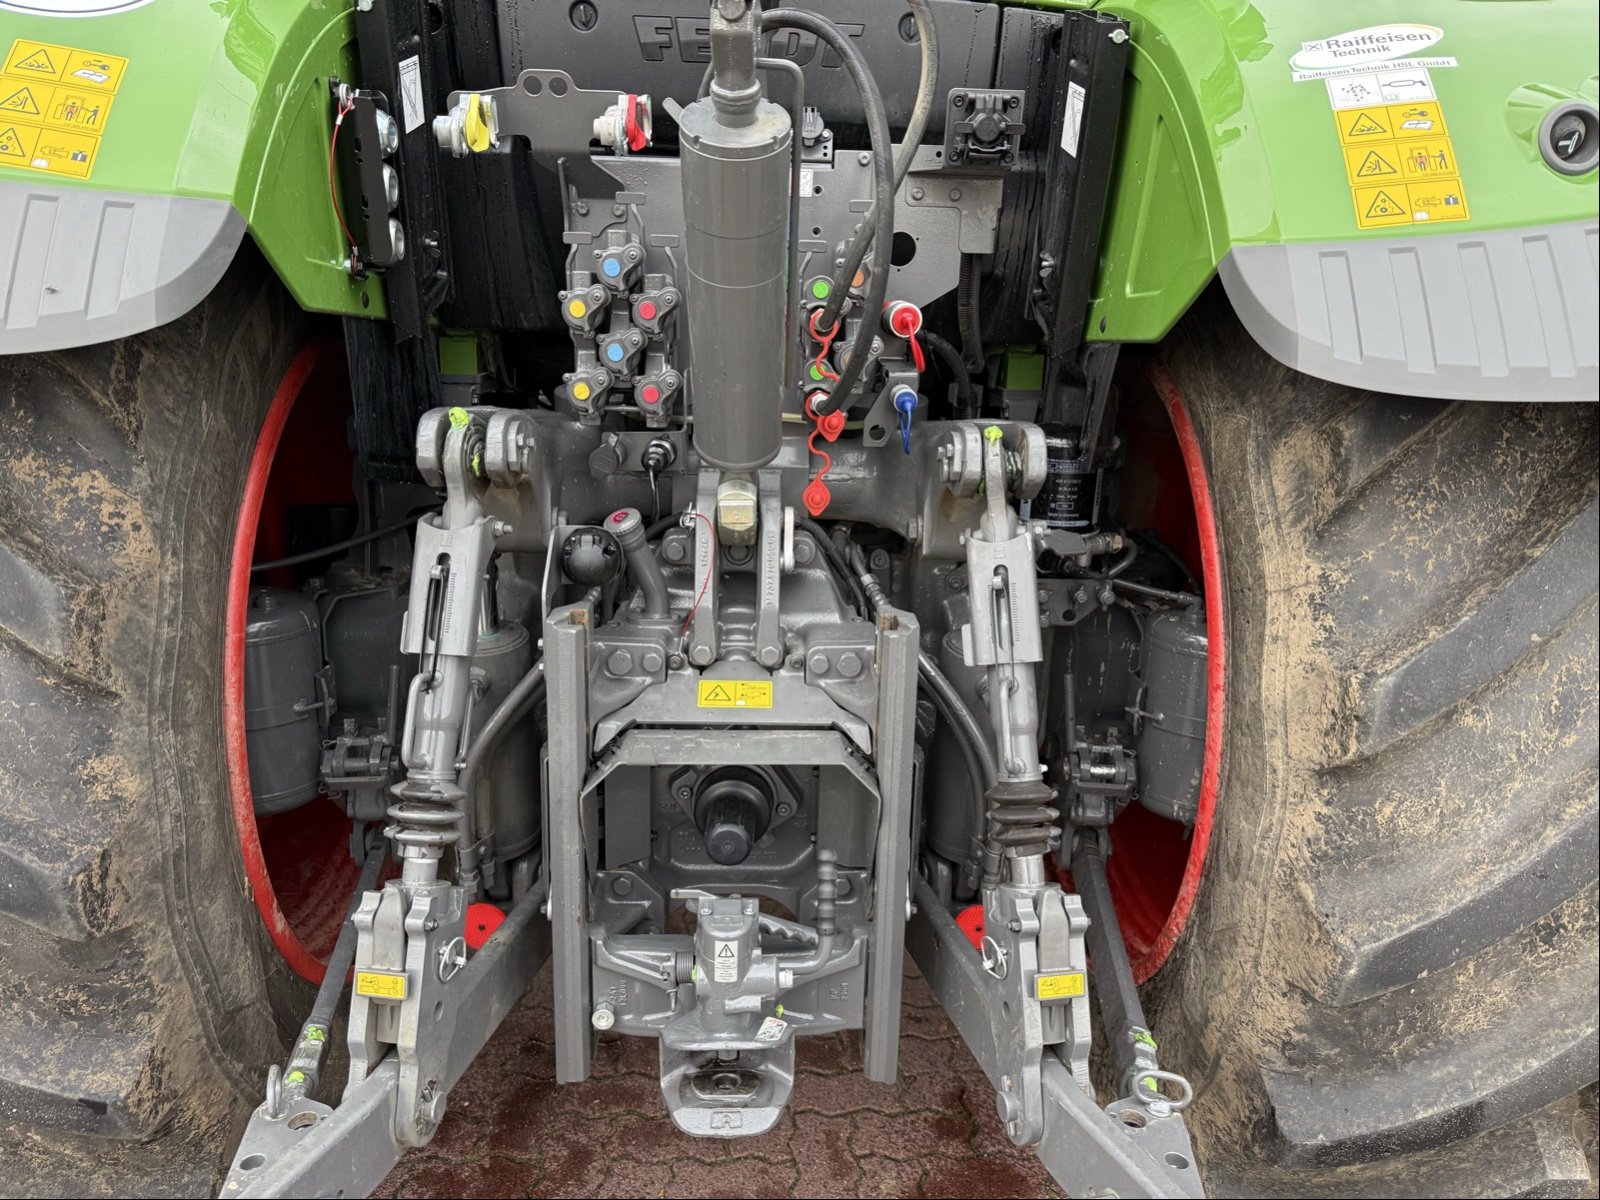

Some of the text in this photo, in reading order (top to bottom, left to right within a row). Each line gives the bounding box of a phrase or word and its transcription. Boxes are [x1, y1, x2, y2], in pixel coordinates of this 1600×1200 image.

[632, 14, 866, 68] FEDT
[1326, 32, 1432, 49] Raiffeisen
[1330, 45, 1391, 58] Technik
[1299, 59, 1451, 80] Raiffeisen Technik HSL GmbH
